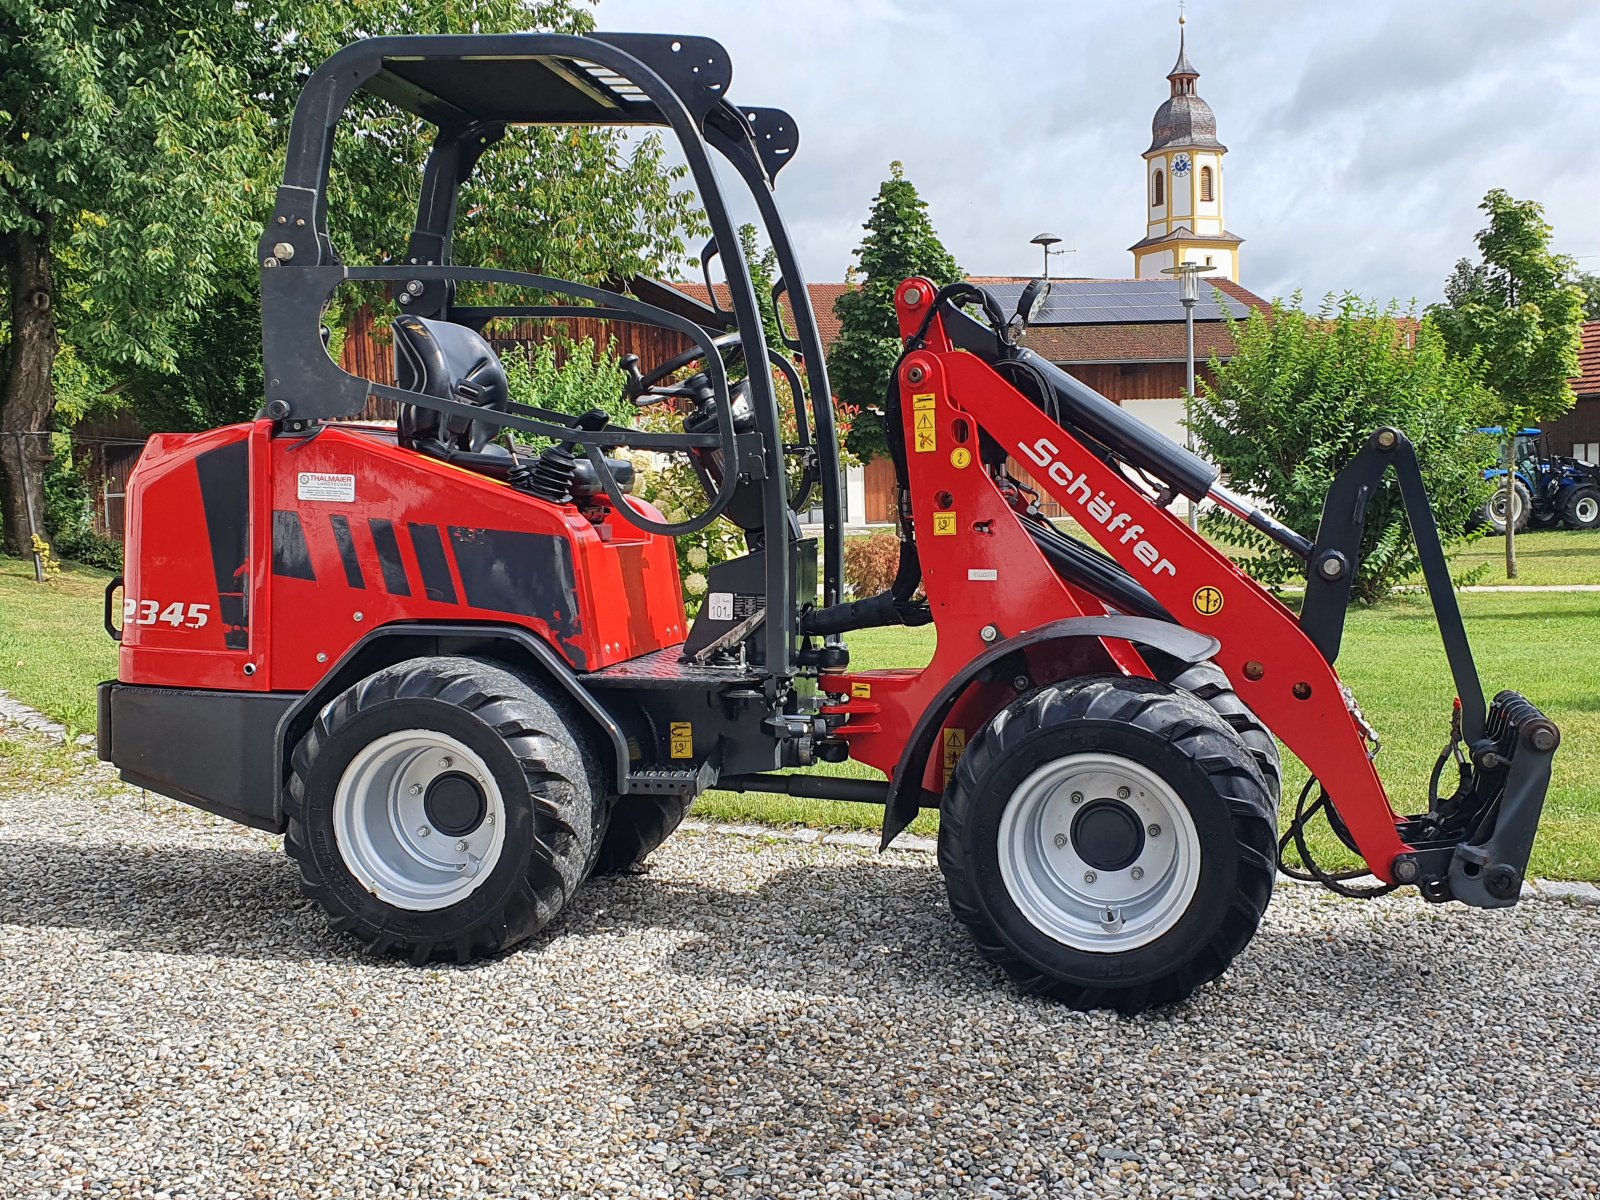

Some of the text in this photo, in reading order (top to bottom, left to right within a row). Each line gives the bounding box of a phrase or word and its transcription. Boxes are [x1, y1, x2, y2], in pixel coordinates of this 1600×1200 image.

[309, 474, 352, 483] THALMAIER
[1017, 438, 1176, 577] Schäffer
[123, 598, 211, 629] 2345
[711, 605, 727, 618] 101
